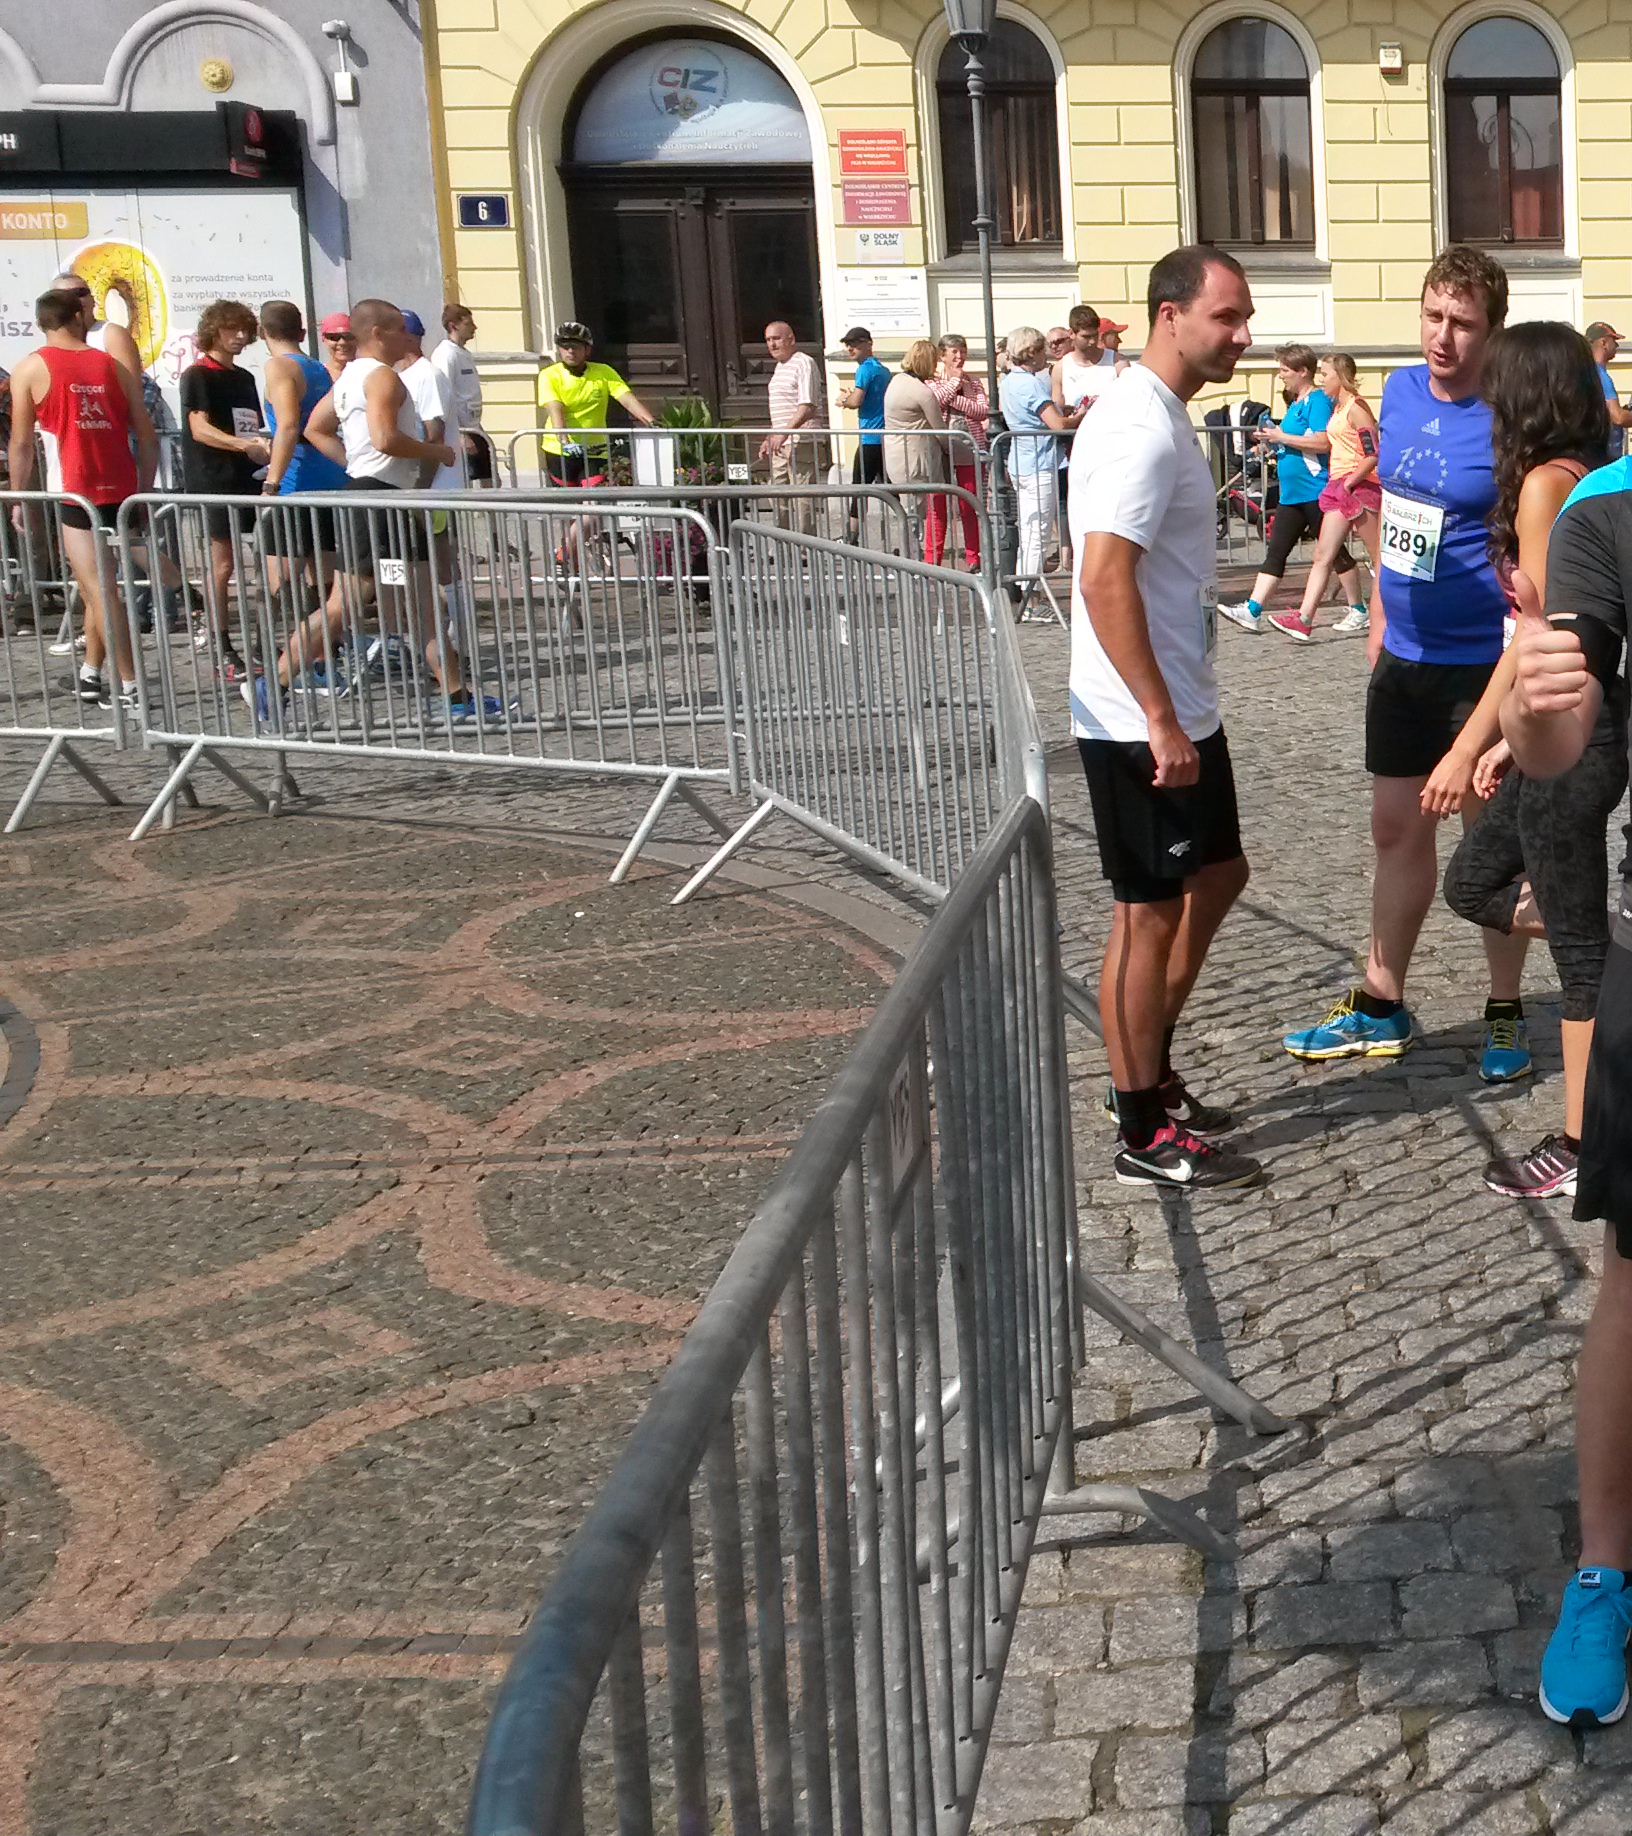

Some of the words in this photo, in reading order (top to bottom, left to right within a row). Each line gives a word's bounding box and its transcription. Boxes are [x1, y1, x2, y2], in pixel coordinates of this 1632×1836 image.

[657, 66, 720, 94] CIZ
[1, 211, 68, 230] KONTO
[478, 201, 488, 221] 6
[873, 232, 900, 240] DOLNY
[171, 275, 182, 283] za
[185, 273, 244, 284] prowadzenie
[247, 272, 274, 282] konta
[172, 291, 183, 299] za
[226, 290, 237, 298] ze
[239, 289, 291, 299] wszystkich
[1382, 521, 1427, 558] 1289
